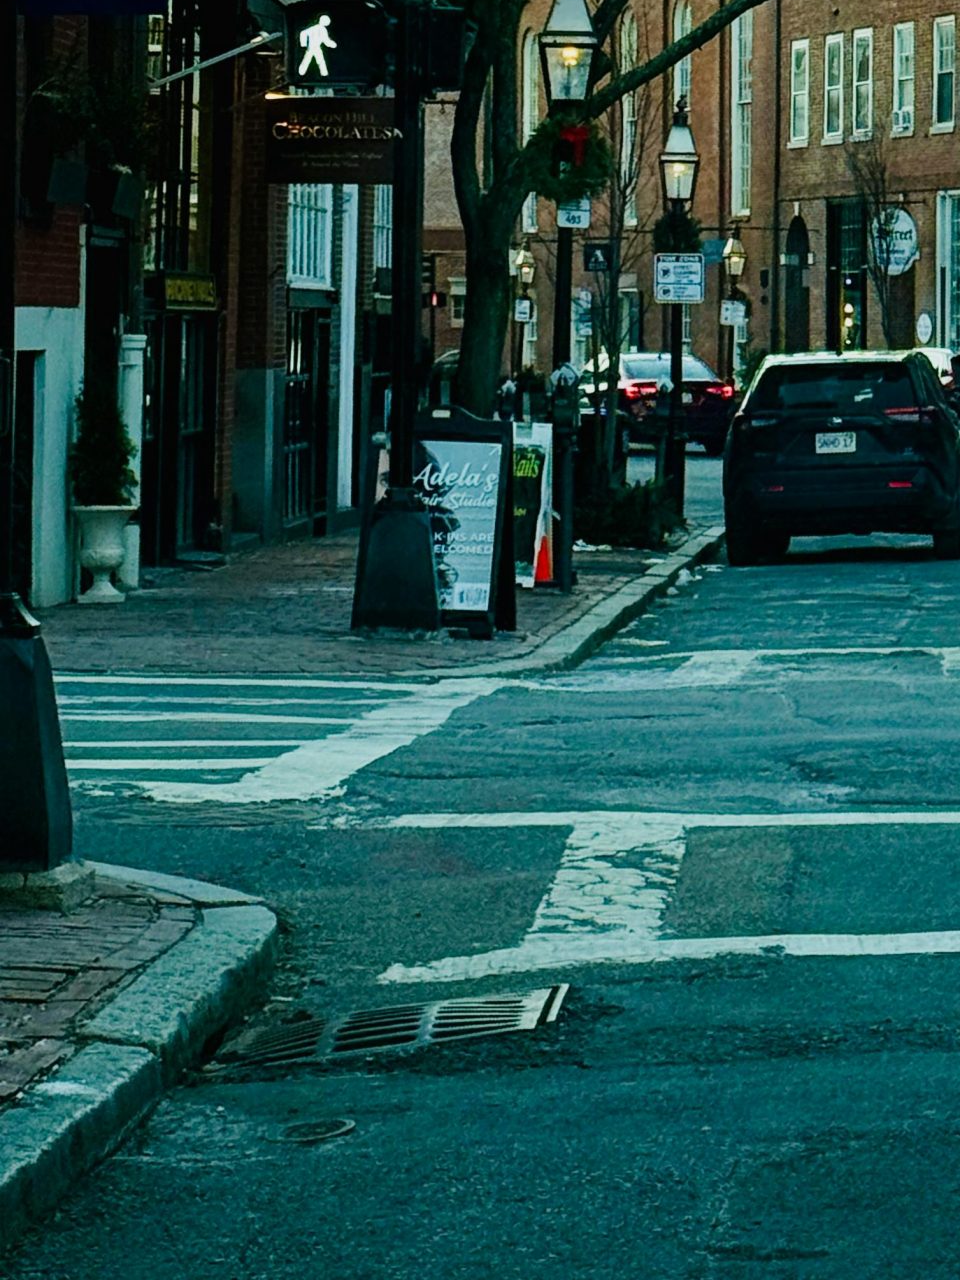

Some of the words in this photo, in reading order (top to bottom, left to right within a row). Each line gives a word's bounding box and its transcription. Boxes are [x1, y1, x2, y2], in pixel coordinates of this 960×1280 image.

[345, 111, 376, 123] HILL
[272, 121, 393, 140] CHOCOLATES
[412, 462, 499, 493] Adela's
[448, 492, 496, 510] Studio
[434, 531, 467, 542] K-INS
[469, 532, 494, 543] ARE
[434, 543, 493, 555] ELCOMED
